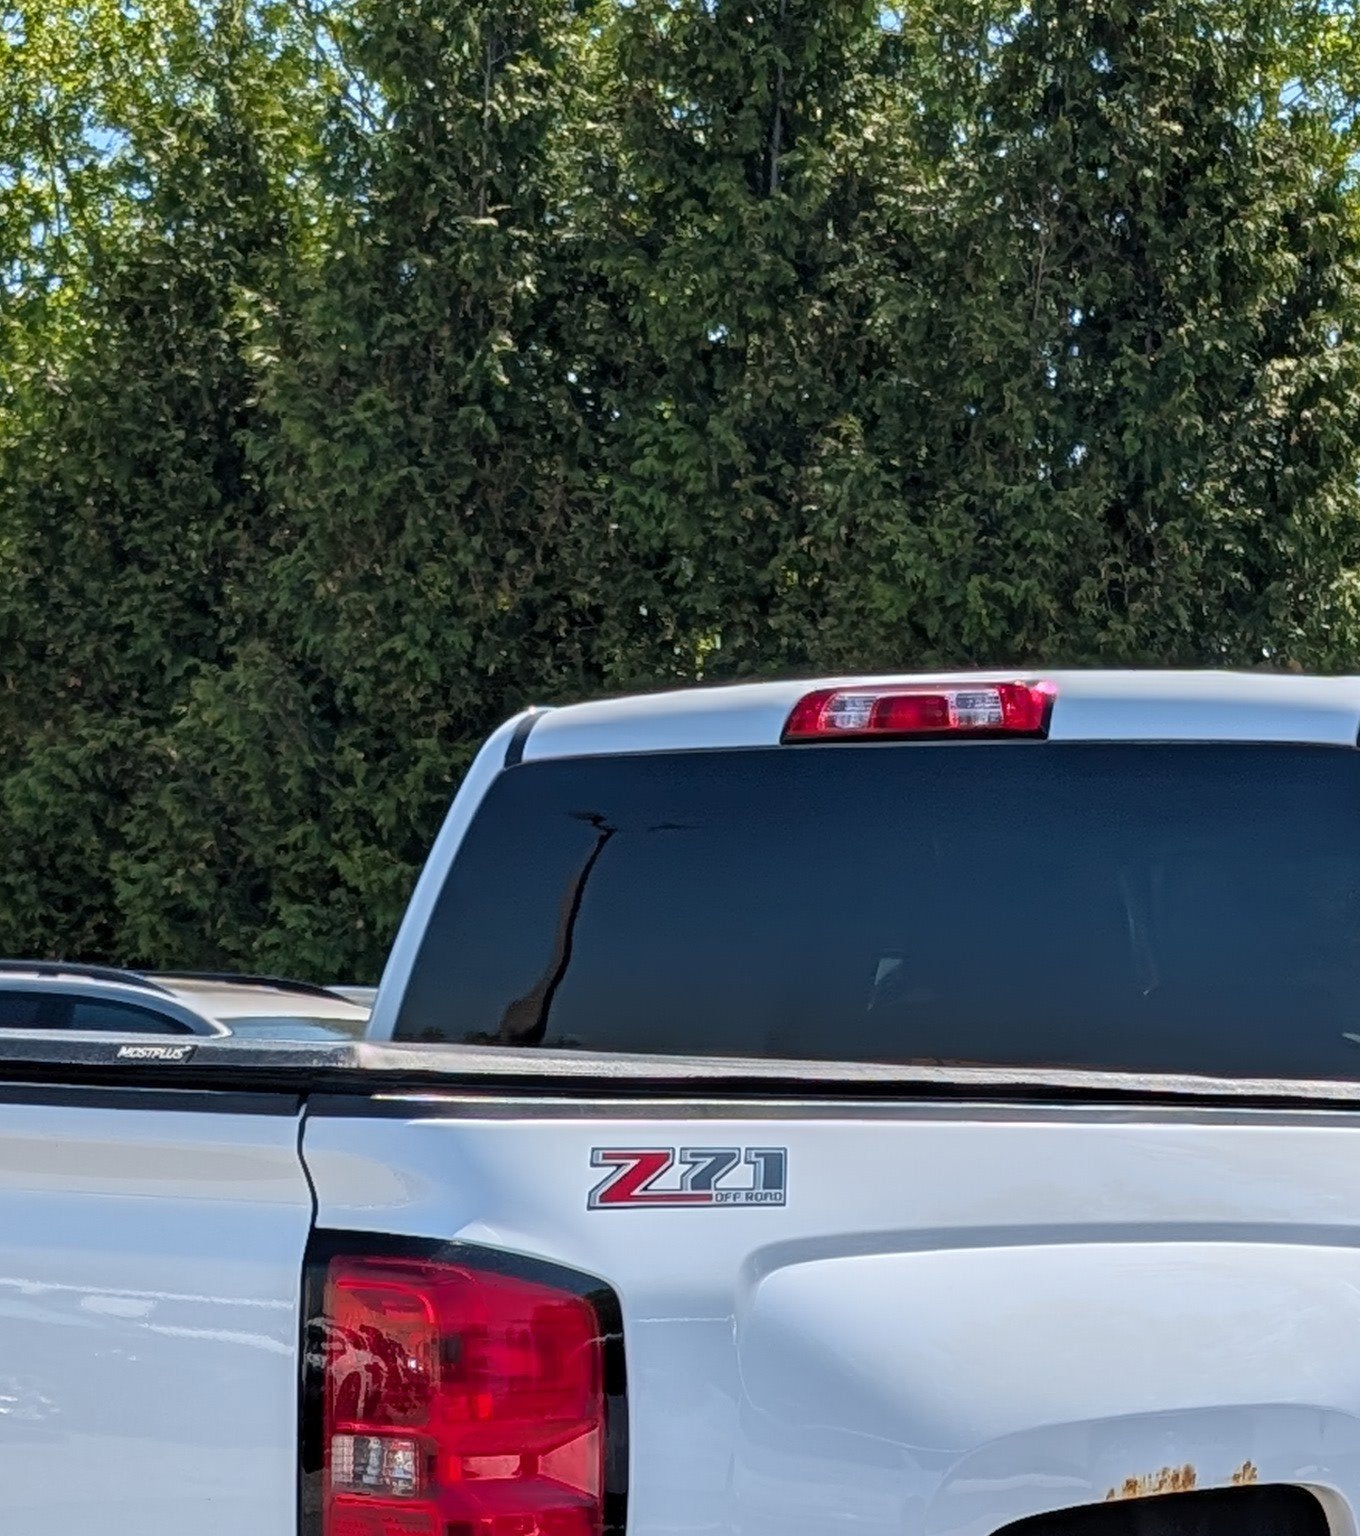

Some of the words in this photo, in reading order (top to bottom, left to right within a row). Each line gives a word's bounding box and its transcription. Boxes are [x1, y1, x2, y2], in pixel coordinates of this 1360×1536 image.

[587, 1147, 787, 1211] Z71
[714, 1191, 742, 1203] OFF
[744, 1191, 783, 1202] ROAD
